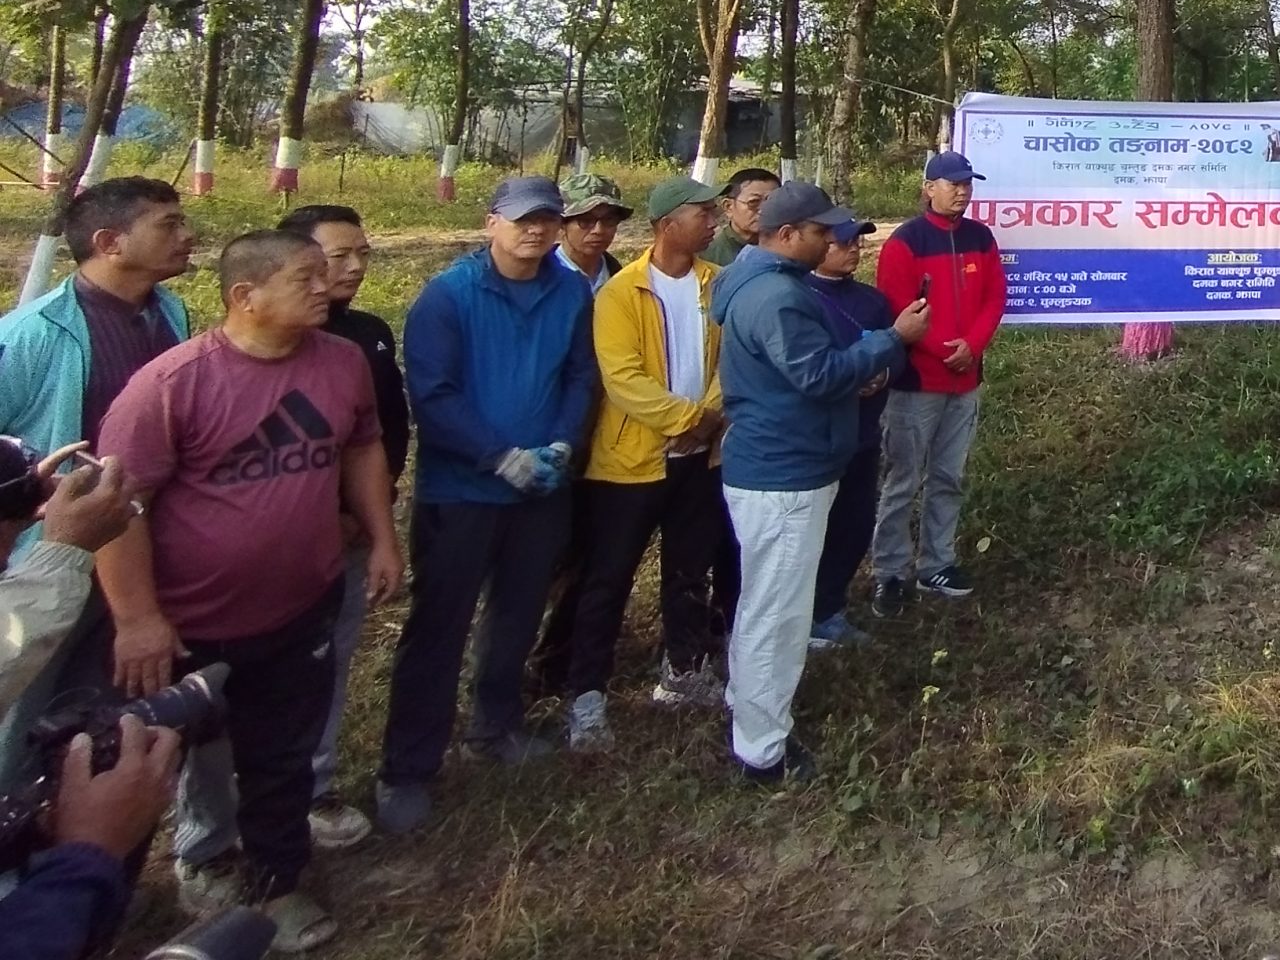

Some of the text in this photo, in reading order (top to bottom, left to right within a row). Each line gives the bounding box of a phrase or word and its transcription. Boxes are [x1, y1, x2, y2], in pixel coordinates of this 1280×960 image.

[1024, 132, 1101, 154] चासोक
[1052, 160, 1080, 172] किरात
[1151, 163, 1174, 173] दमक
[1177, 163, 1197, 173] नगर
[1200, 161, 1228, 173] समिति
[1143, 175, 1168, 186] झापा
[970, 200, 1122, 229] पत्रकार
[1023, 270, 1053, 282] मंसिर
[1070, 270, 1088, 281] गते
[1184, 265, 1215, 277] किरात
[1192, 276, 1276, 289] दमक नगर समिति
[1235, 290, 1262, 300] झापा
